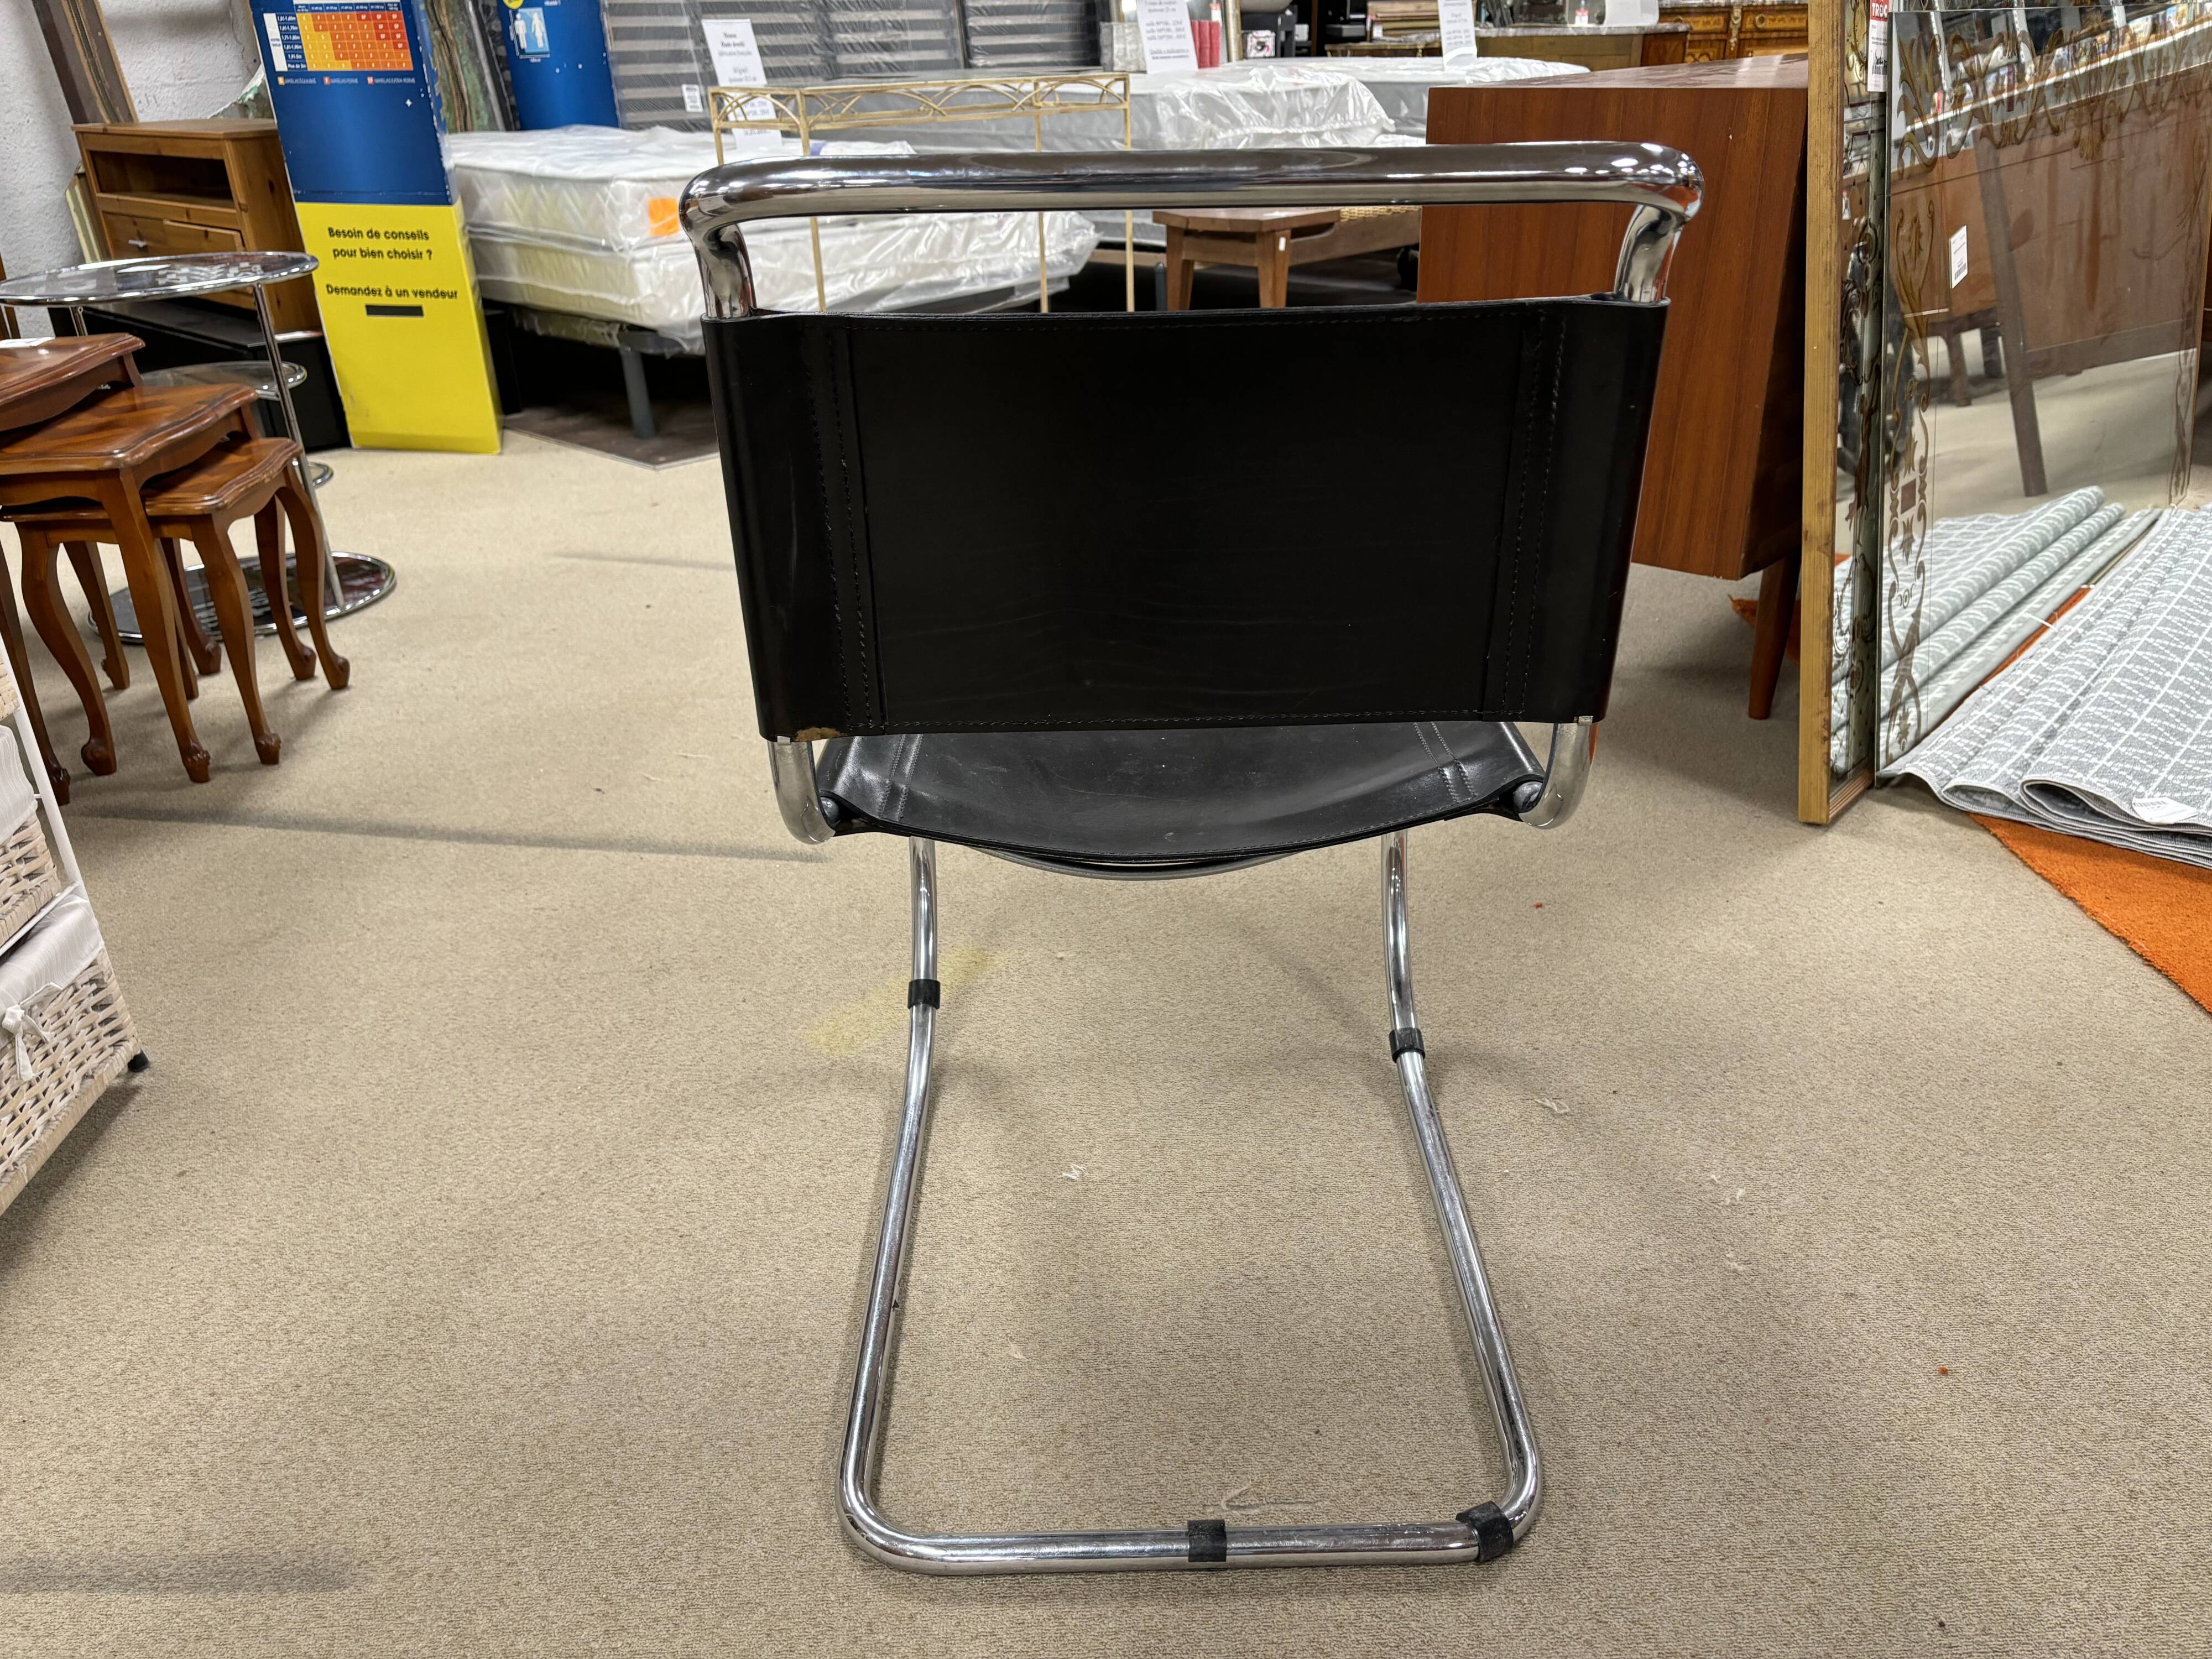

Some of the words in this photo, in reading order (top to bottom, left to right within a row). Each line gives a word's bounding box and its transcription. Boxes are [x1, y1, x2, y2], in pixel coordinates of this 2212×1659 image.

[1872, 2, 1888, 18] TROC
[327, 227, 364, 239] Besoin
[366, 227, 381, 239] de
[383, 229, 430, 241] conseils
[332, 248, 357, 260] pour
[359, 247, 384, 259] bien
[387, 248, 423, 260] choisir
[426, 249, 433, 260] ?
[326, 284, 383, 298] Demandez
[385, 285, 393, 297] à
[395, 288, 410, 298] un
[411, 288, 458, 300] vendeur
